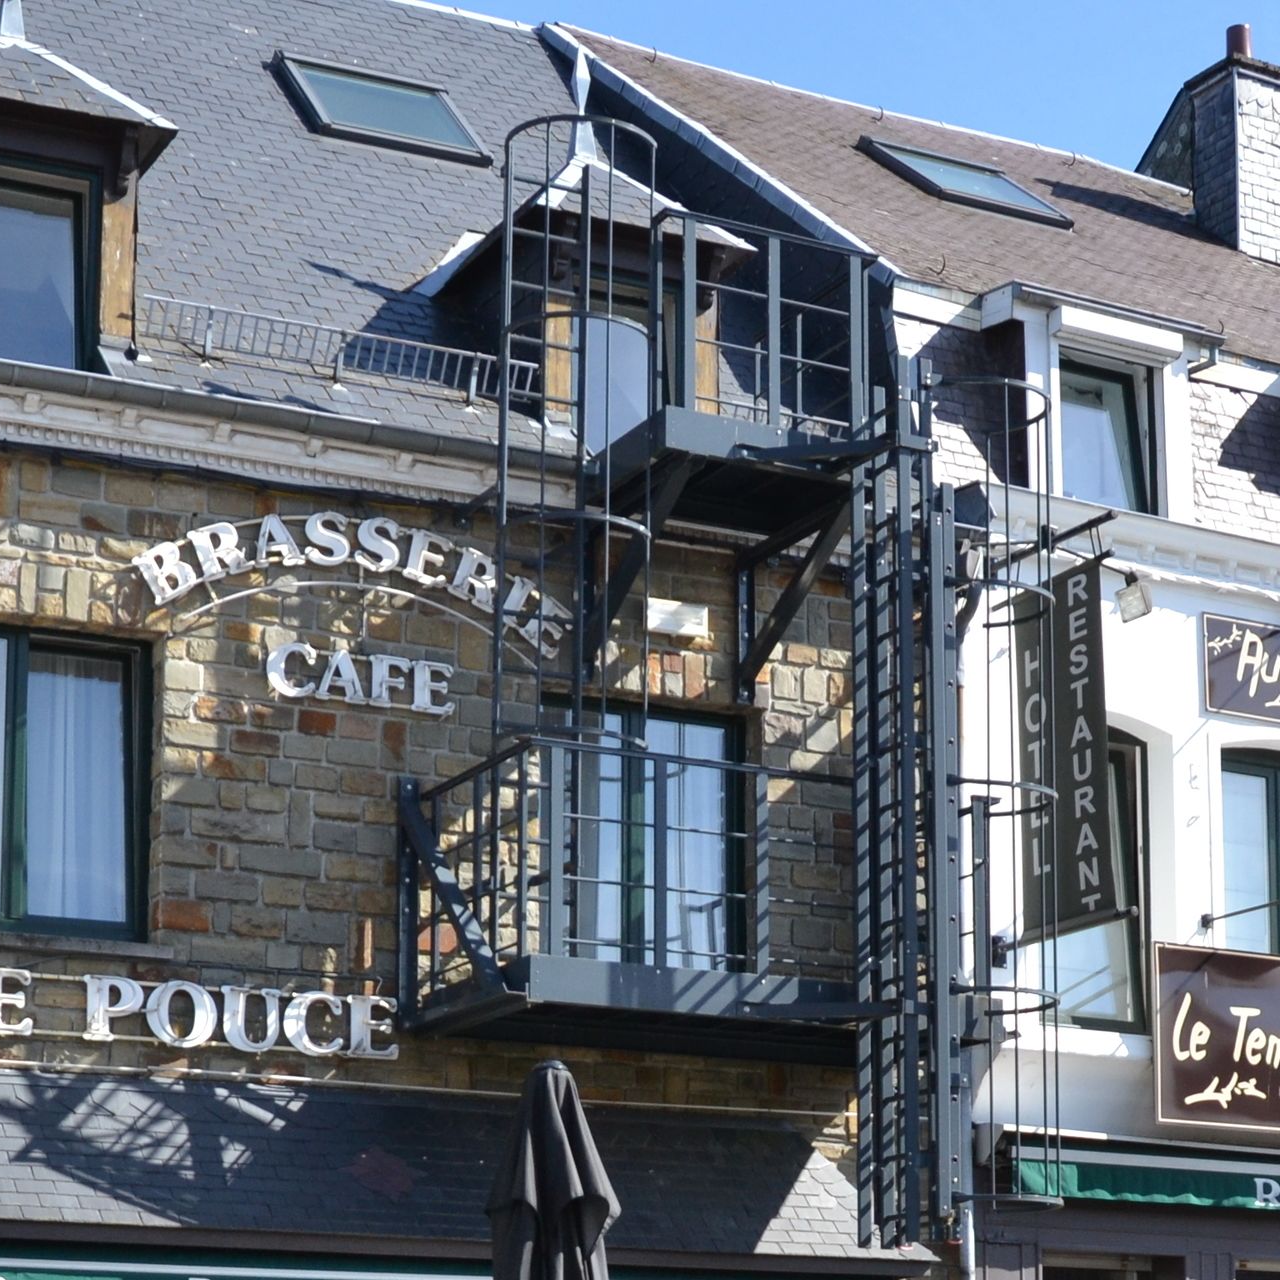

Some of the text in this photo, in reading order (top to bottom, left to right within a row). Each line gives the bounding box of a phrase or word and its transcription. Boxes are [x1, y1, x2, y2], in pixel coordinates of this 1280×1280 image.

[131, 511, 575, 659] BRASSERIE
[267, 643, 455, 715] CAFE
[1023, 647, 1051, 877] HOTEL
[1067, 573, 1101, 912] RESTAURANT
[82, 974, 398, 1060] POUCE
[1172, 992, 1211, 1062] Le
